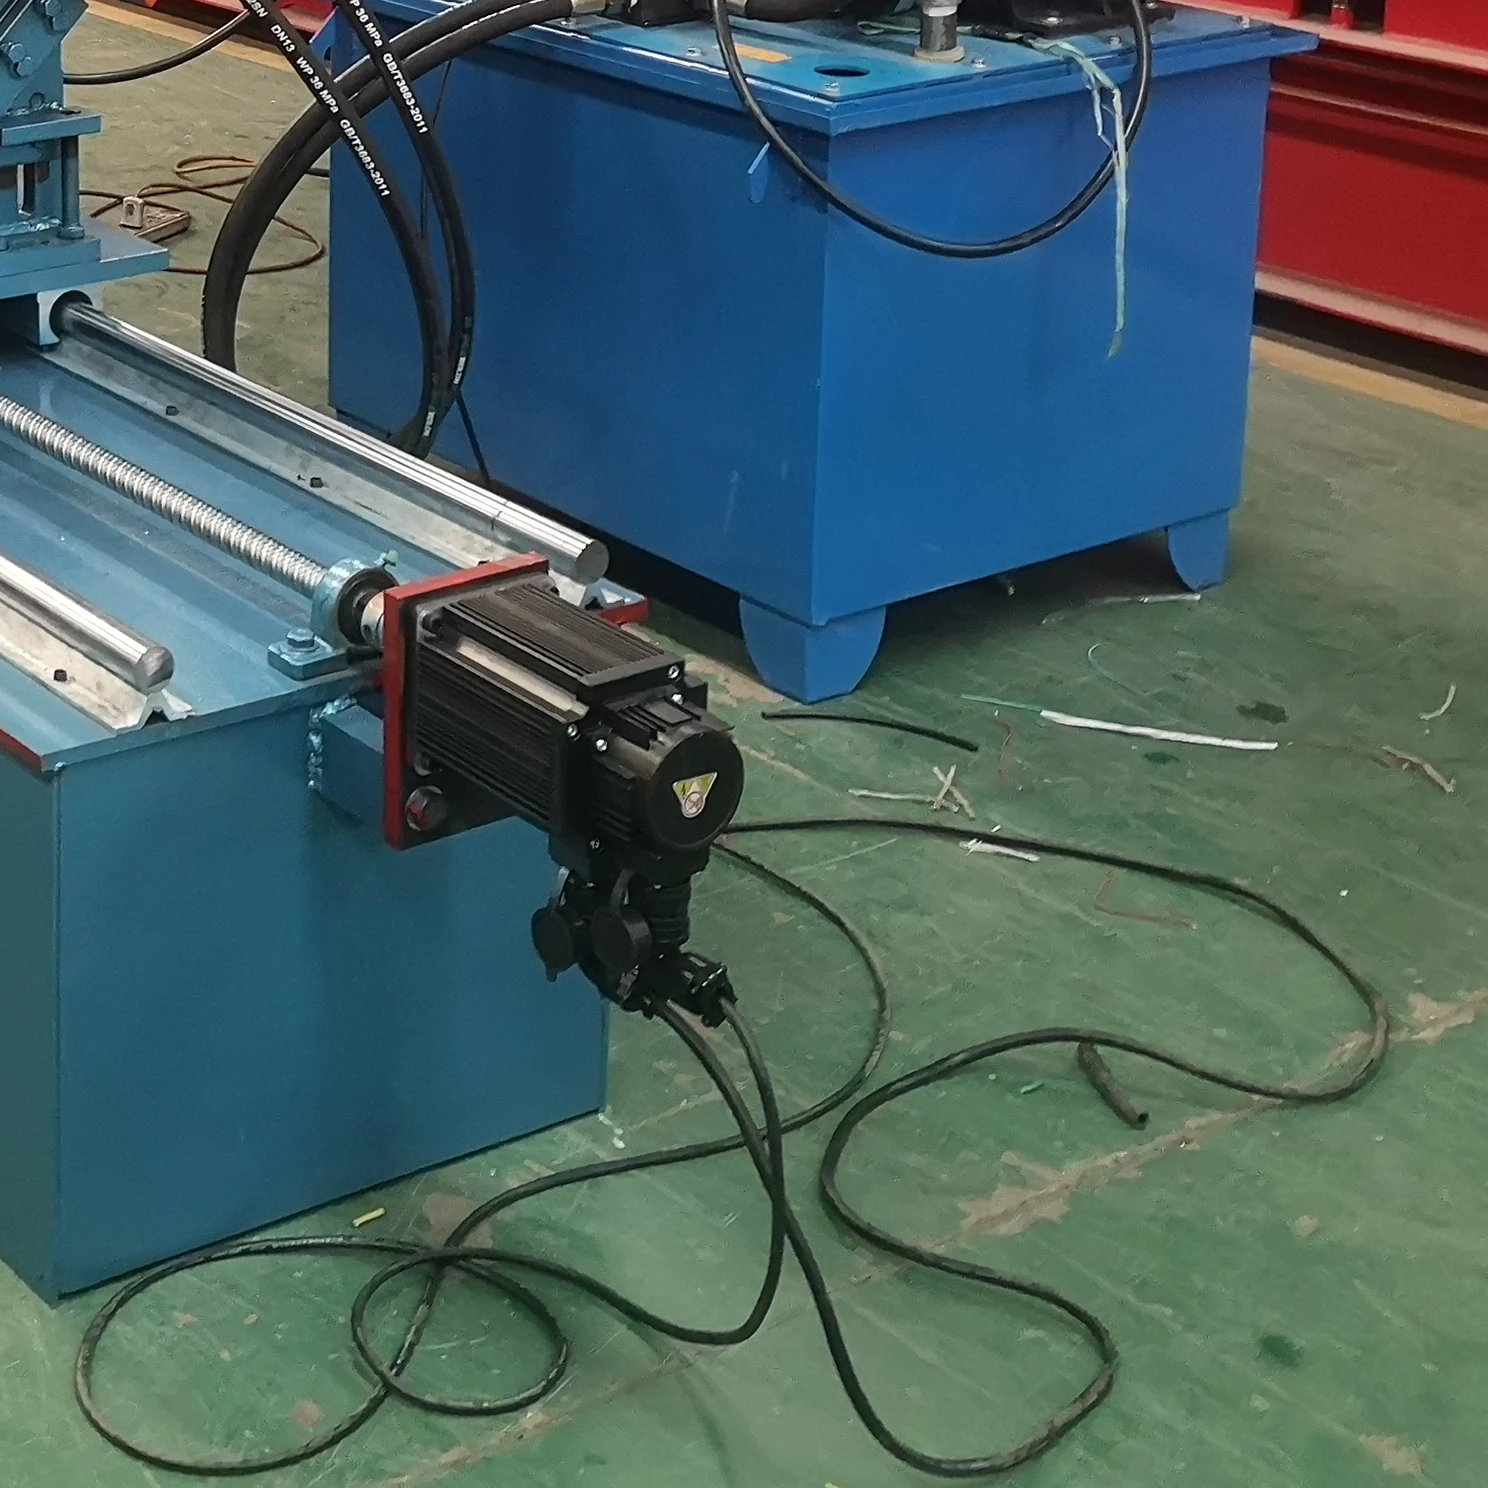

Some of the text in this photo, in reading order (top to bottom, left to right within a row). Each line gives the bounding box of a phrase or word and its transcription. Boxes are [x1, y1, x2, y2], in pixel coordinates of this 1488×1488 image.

[364, 21, 383, 47] MPa
[270, 24, 297, 53] DN13
[296, 56, 313, 76] WP
[319, 89, 339, 114] MPa
